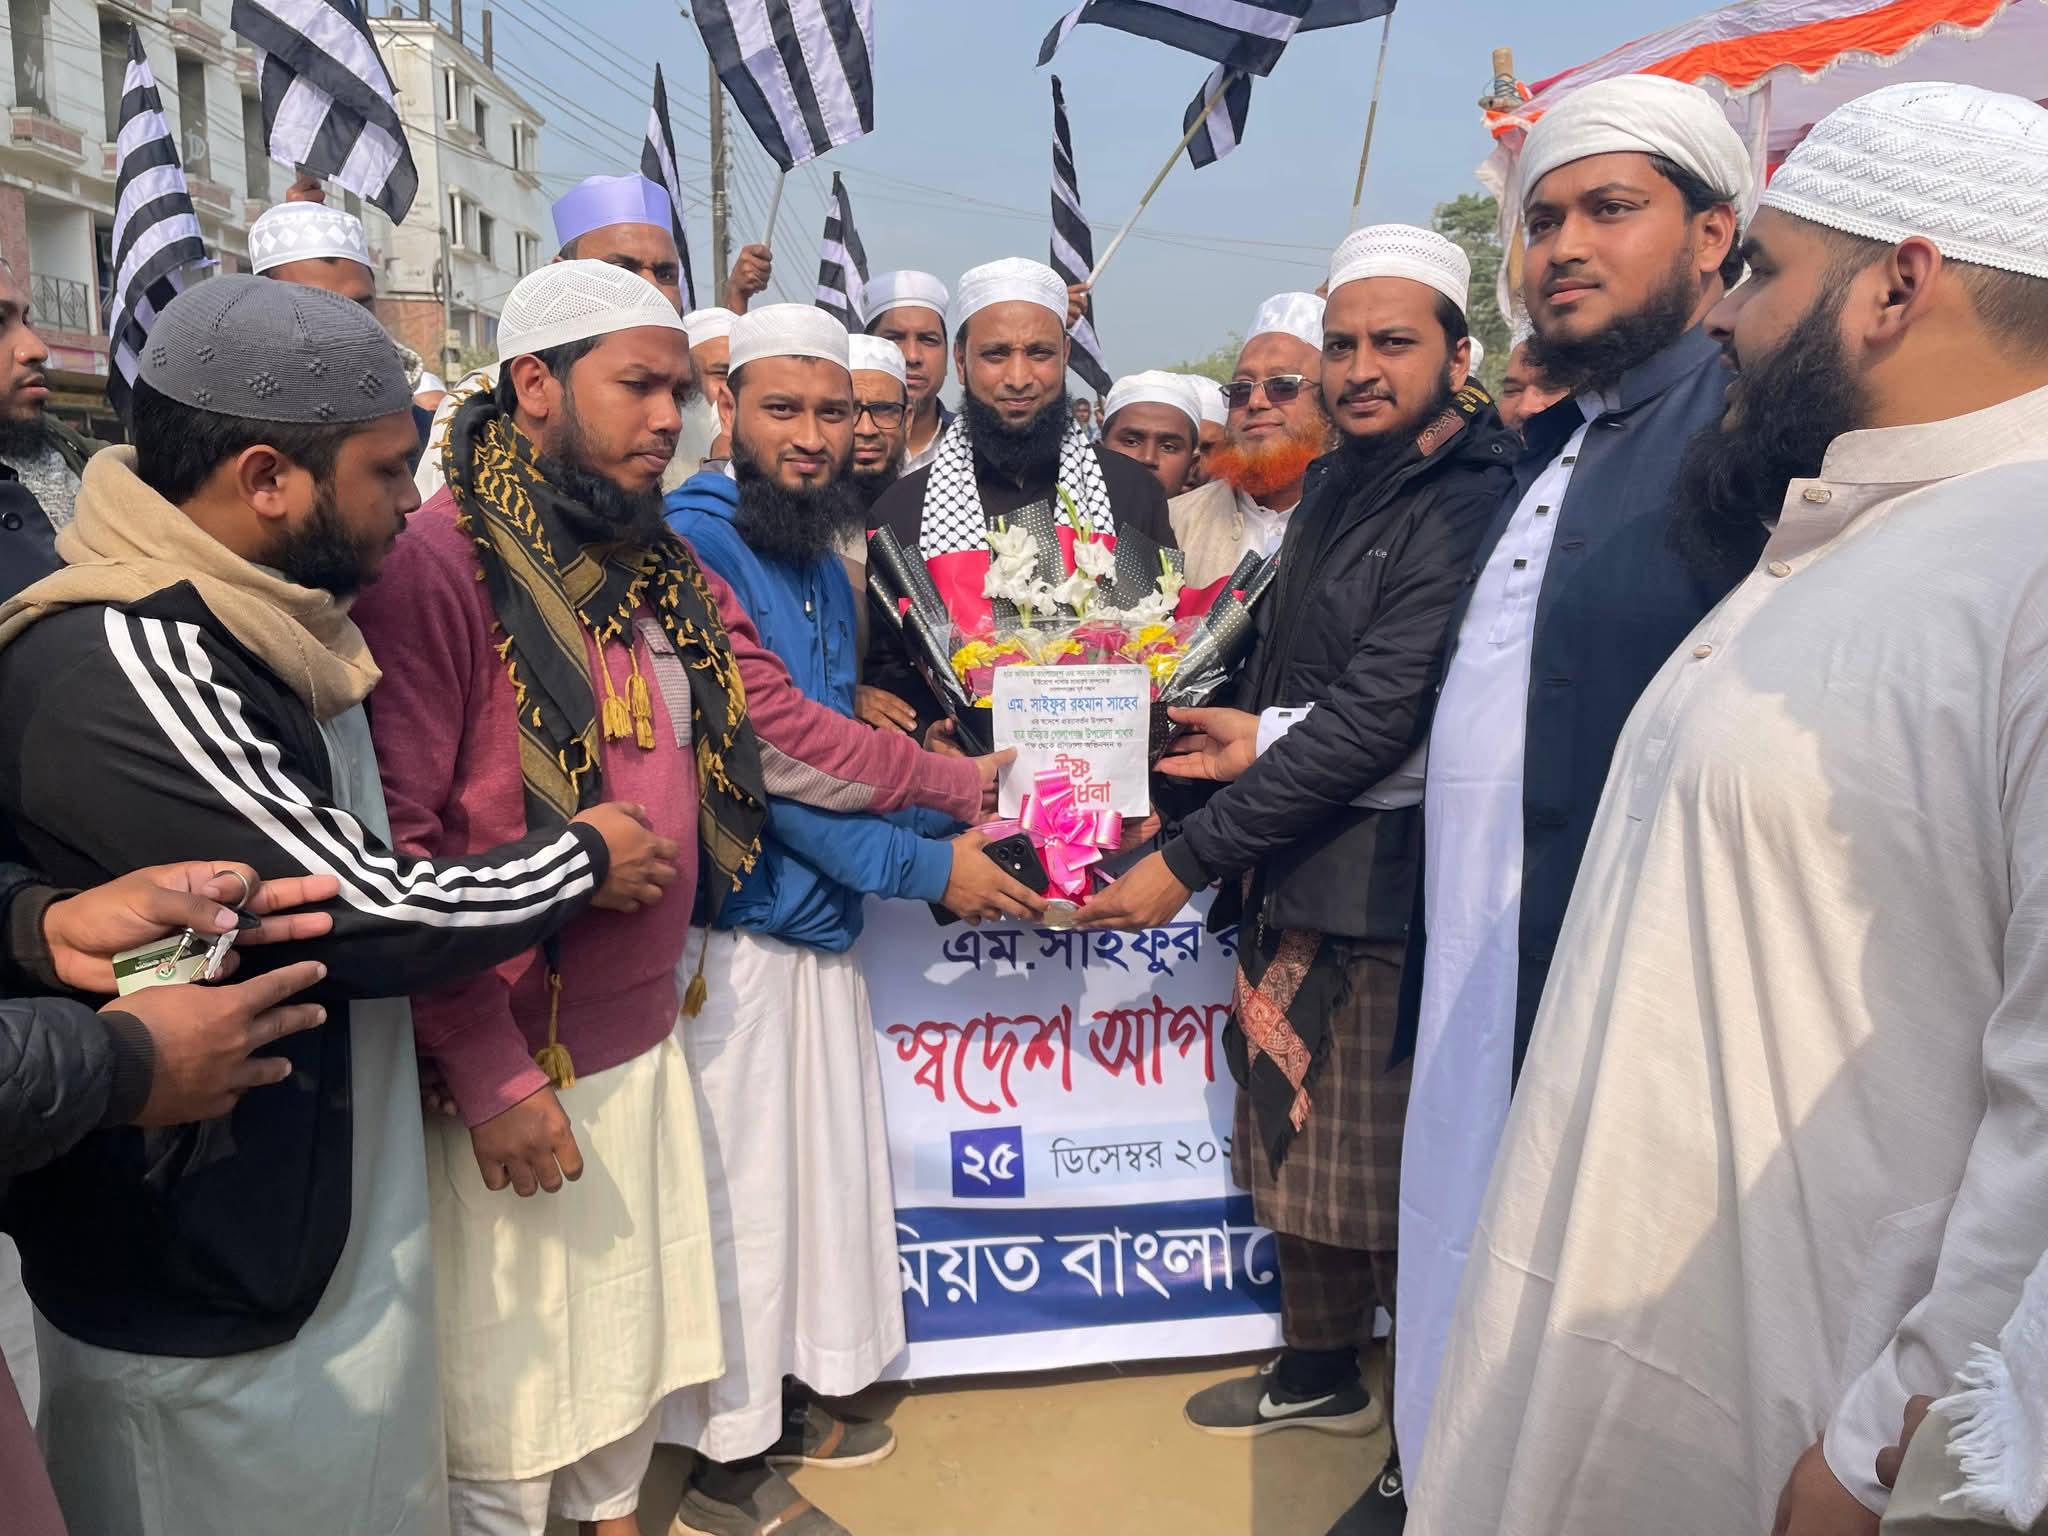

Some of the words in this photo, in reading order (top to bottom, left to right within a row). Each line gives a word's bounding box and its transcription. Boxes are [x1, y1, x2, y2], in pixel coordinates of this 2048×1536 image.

[1031, 694, 1066, 715] সাইফুর
[1070, 697, 1103, 713] রহমান
[1107, 695, 1139, 712] সাহেব
[961, 1143, 1021, 1186] ২৫
[1050, 1137, 1163, 1179] ডিসেম্বর
